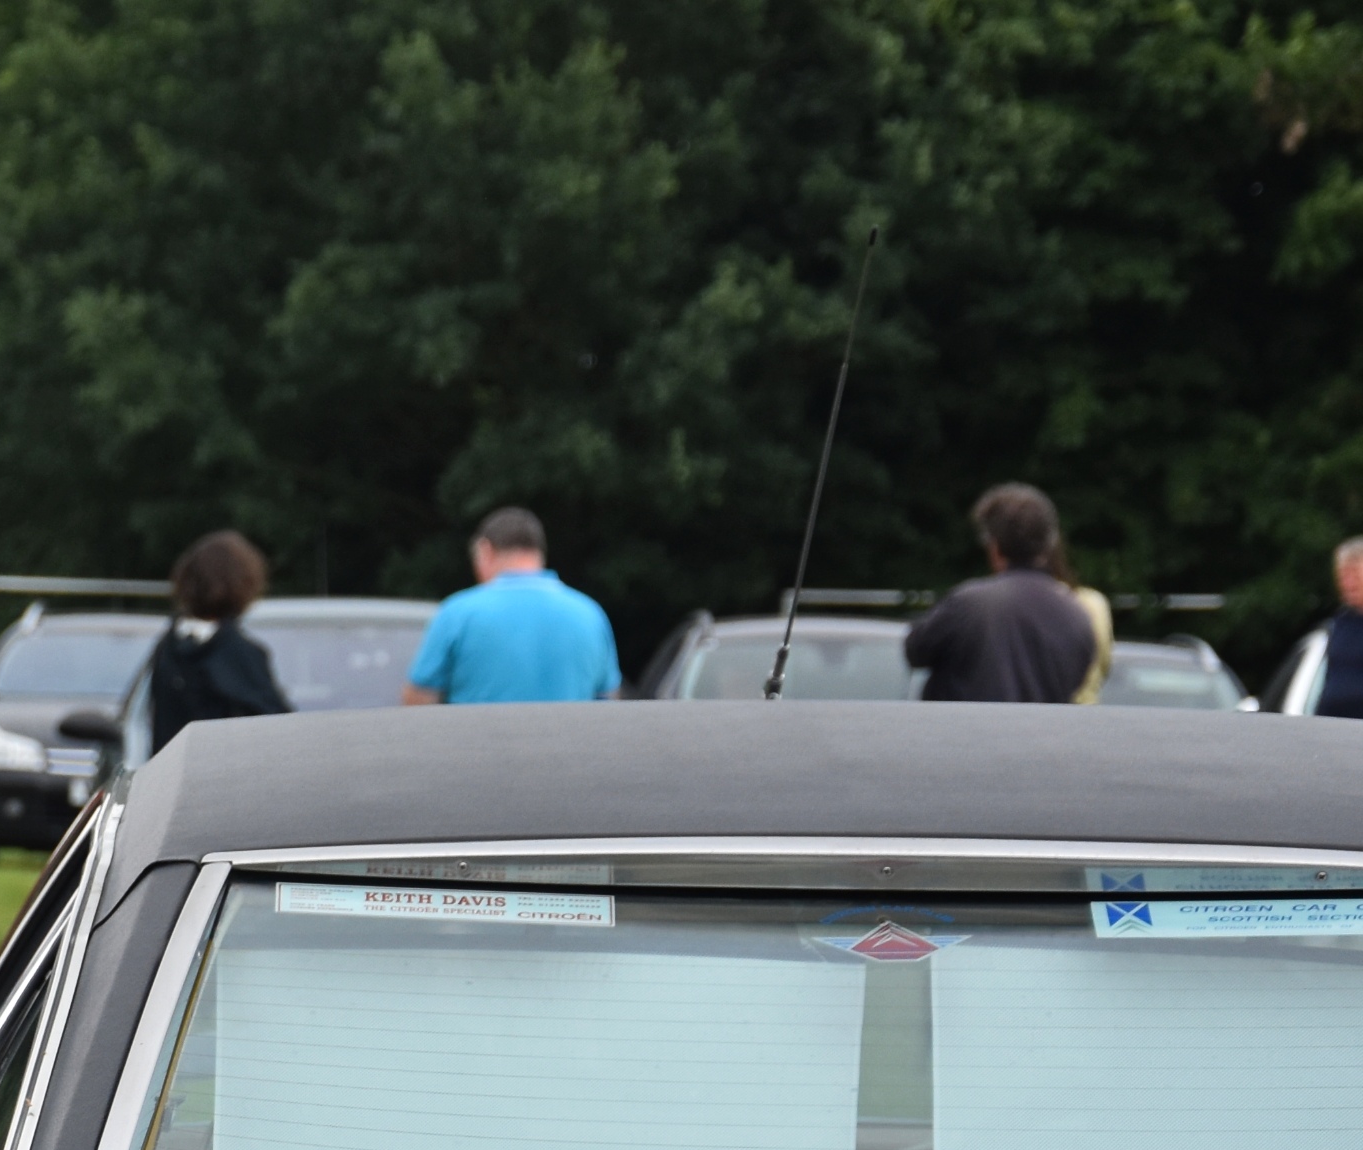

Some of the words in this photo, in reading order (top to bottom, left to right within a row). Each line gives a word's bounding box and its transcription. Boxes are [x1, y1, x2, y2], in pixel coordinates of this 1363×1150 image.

[364, 891, 432, 904] KEITH
[442, 895, 506, 907] DAVIS
[443, 908, 507, 917] SPECIALIST
[1179, 904, 1274, 913] CITROEN
[1292, 903, 1338, 912] CAR
[517, 911, 602, 921] CITROËN
